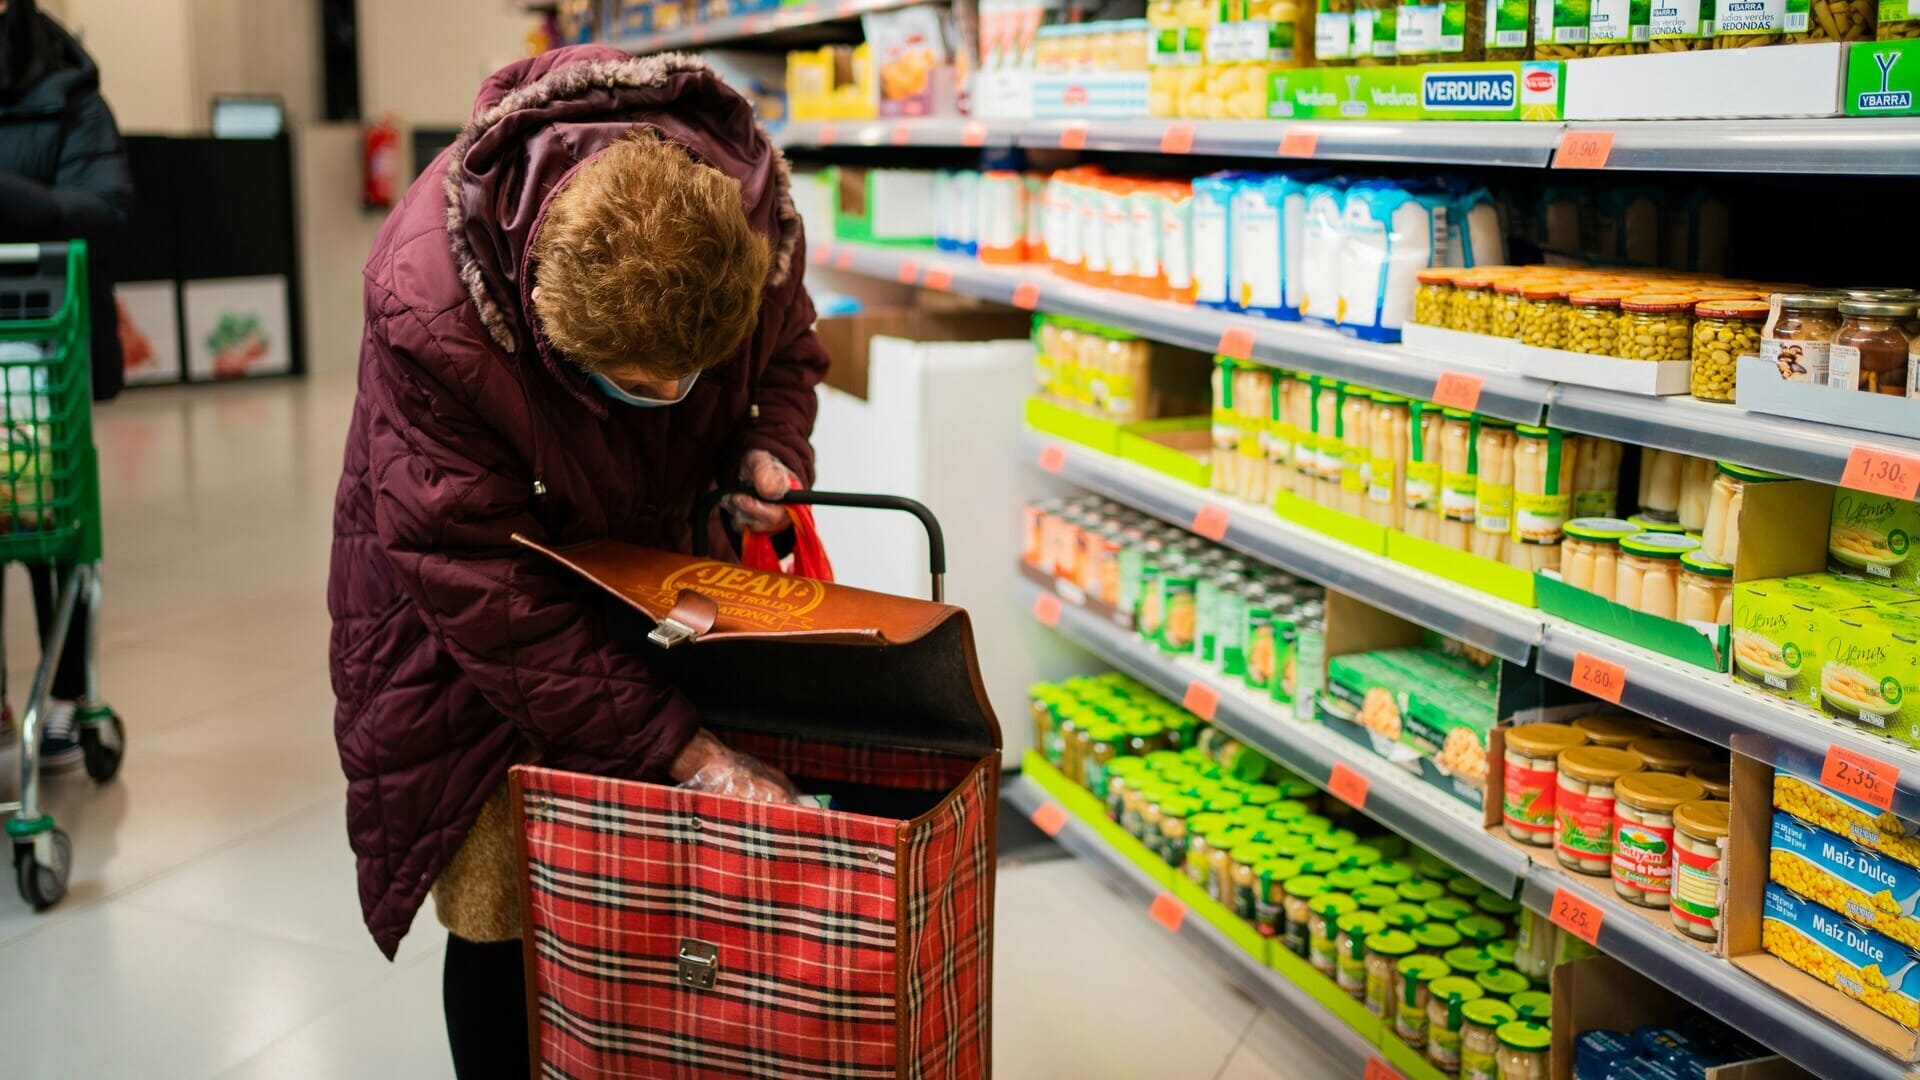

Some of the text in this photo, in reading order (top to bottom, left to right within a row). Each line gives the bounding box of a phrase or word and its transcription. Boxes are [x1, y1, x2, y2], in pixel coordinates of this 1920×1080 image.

[1722, 21, 1771, 31] REDONDAS
[1427, 80, 1513, 101] VERDURAS
[1862, 94, 1908, 106] YBARRA
[699, 566, 803, 598] JEAN
[739, 593, 798, 612] TROLLEY
[1822, 842, 1896, 887] Maíz Dulce
[1813, 914, 1884, 962] Maíz Dulce
